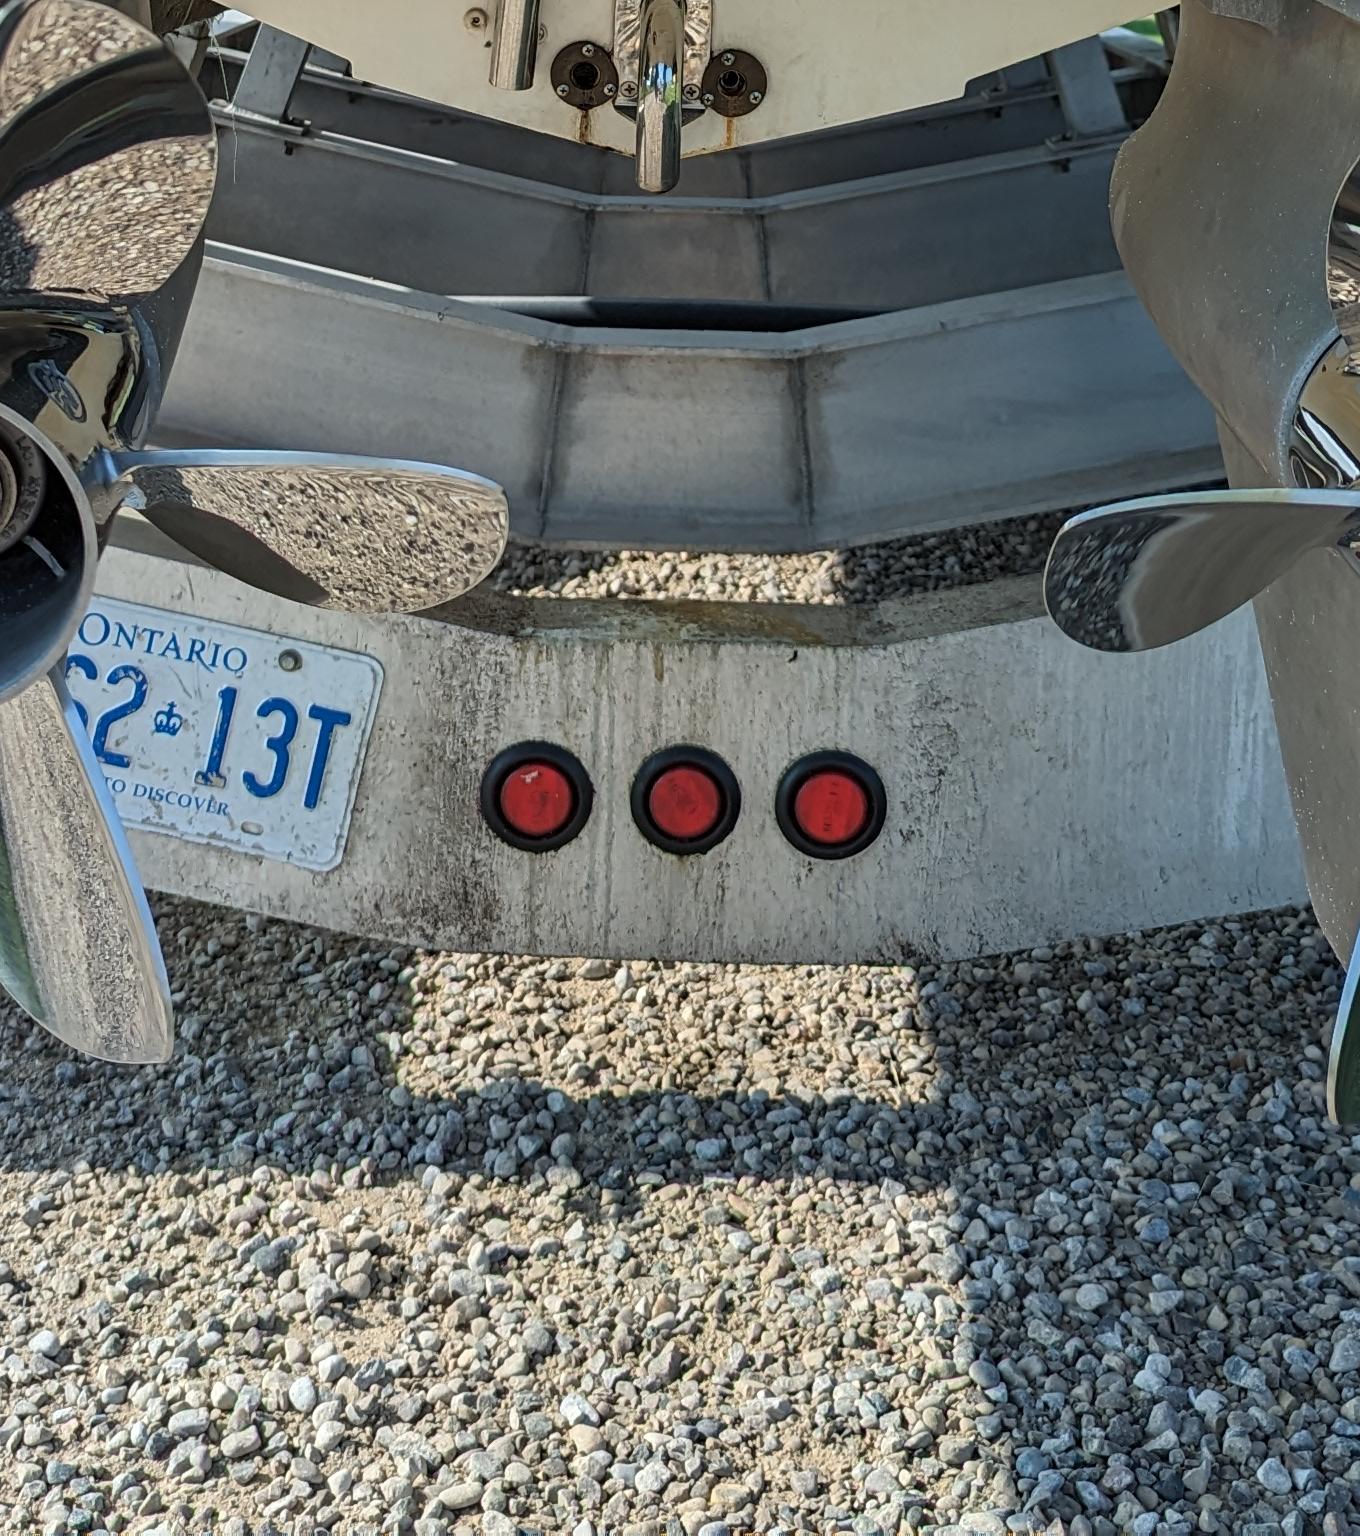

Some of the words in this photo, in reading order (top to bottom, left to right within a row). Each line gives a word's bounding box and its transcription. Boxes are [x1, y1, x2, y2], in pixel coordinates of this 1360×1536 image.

[78, 612, 248, 674] ONTARIO
[193, 685, 353, 810] 13T
[132, 782, 230, 816] DISCOVER
